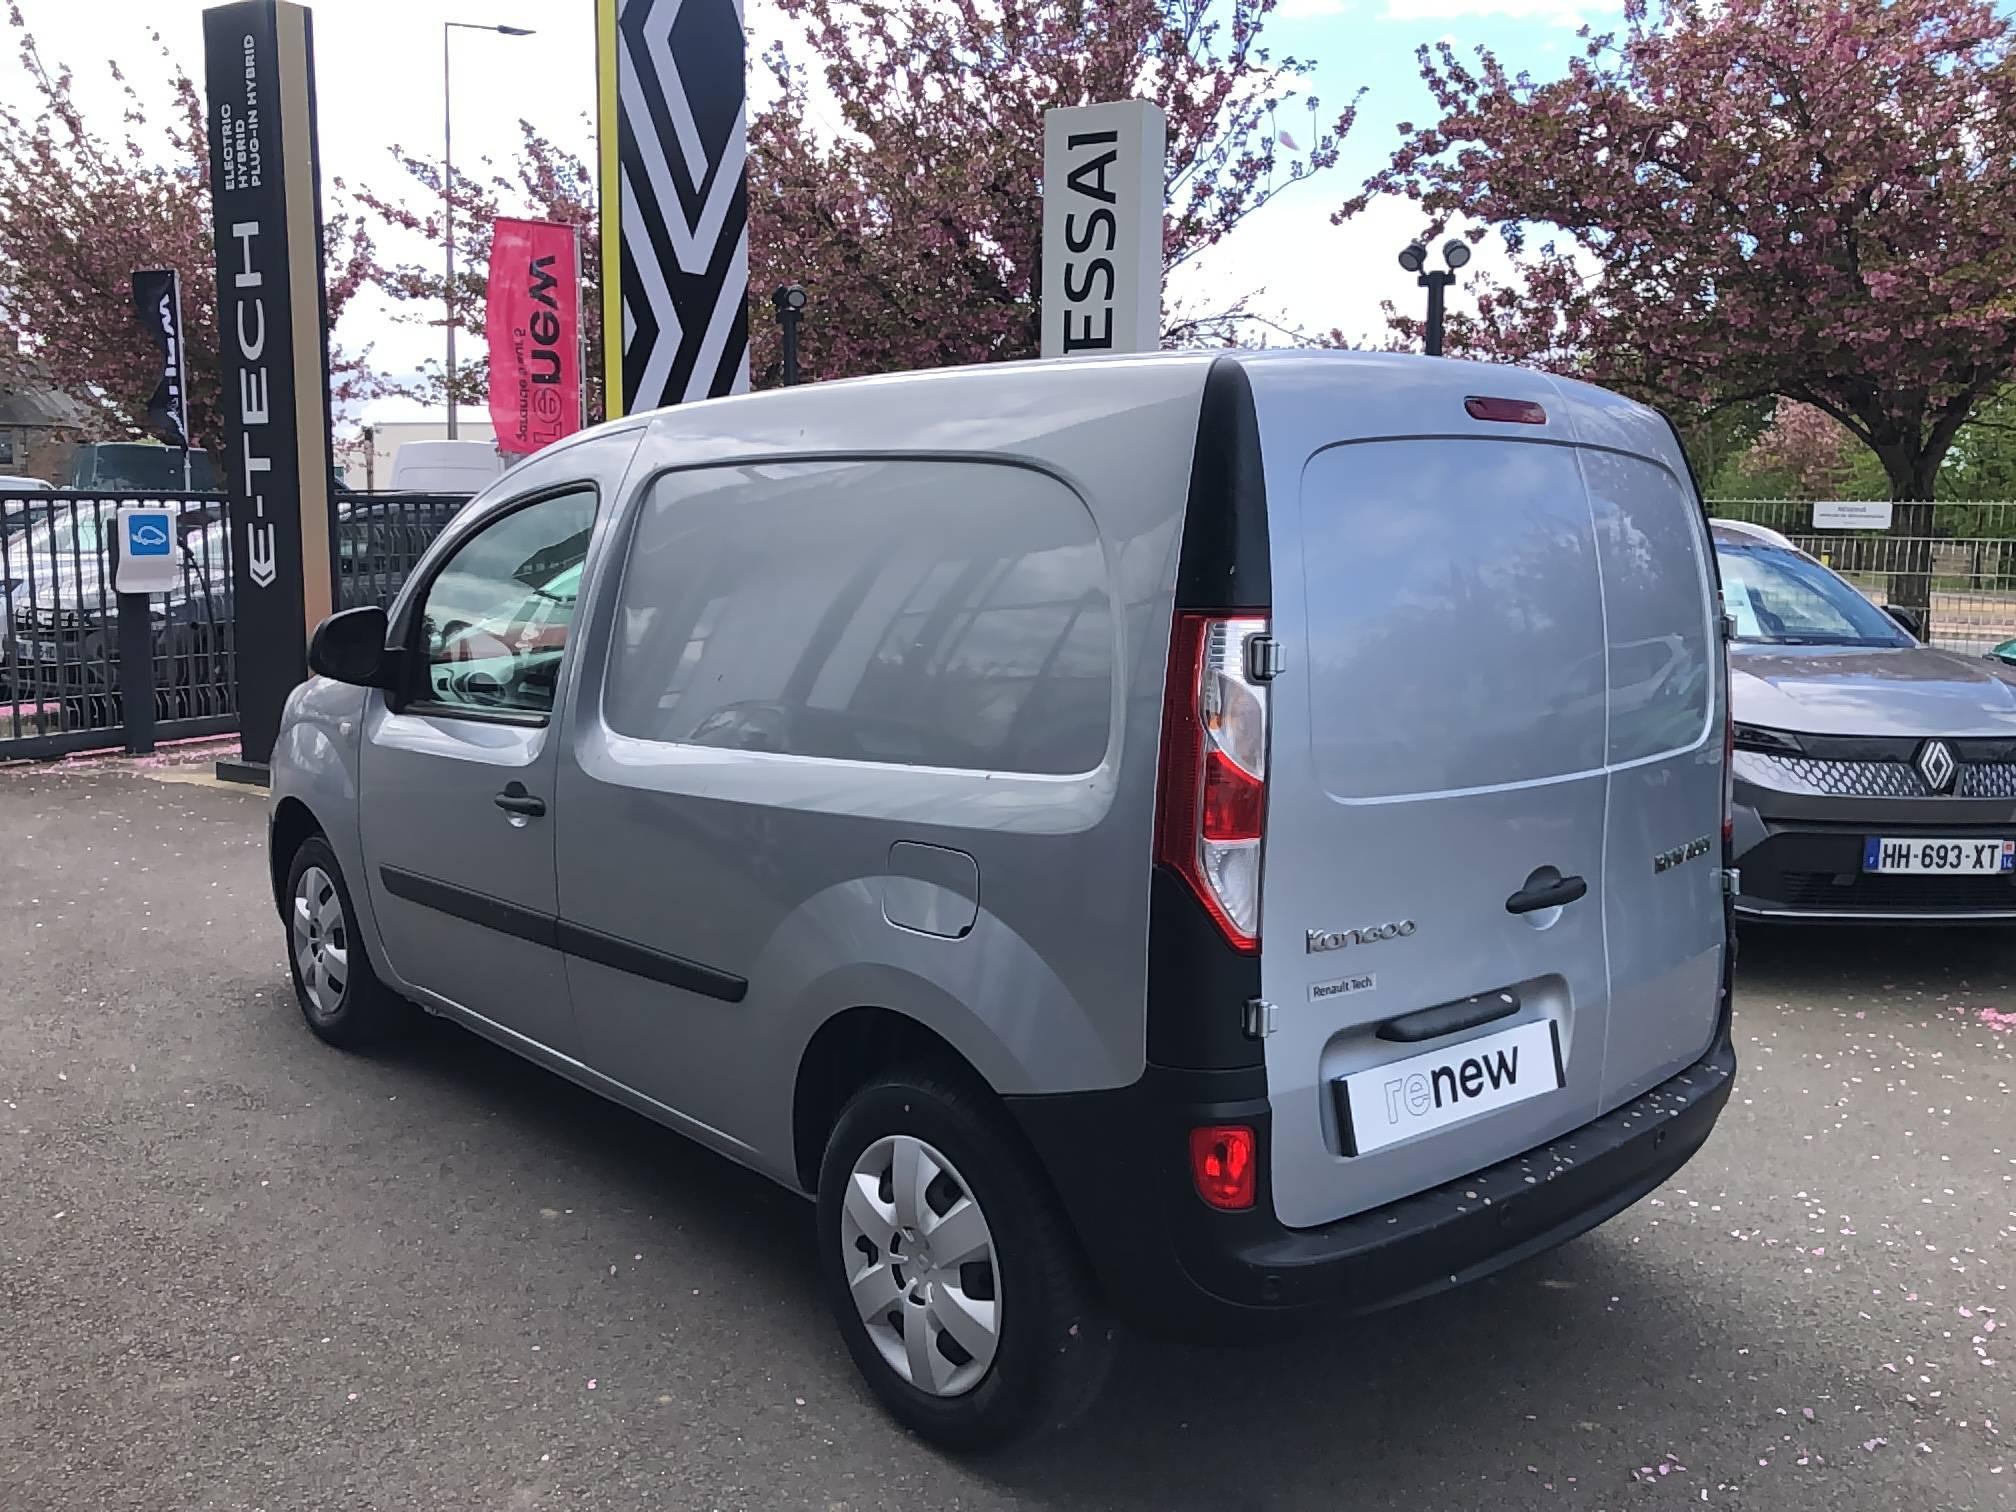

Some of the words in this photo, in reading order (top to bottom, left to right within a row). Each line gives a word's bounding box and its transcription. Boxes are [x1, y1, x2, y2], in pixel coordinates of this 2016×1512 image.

[243, 34, 257, 105] HYBRID
[221, 103, 235, 190] ELECTRIC
[235, 119, 249, 189] HYBRID
[248, 109, 262, 187] PLUG-IN
[1063, 130, 1118, 354] ESSAI
[233, 221, 277, 588] E-TECH
[1882, 843, 2000, 869] HH-693-XT
[1313, 981, 1349, 998] Renault
[1351, 976, 1373, 989] Tech
[1384, 1046, 1518, 1124] renew
